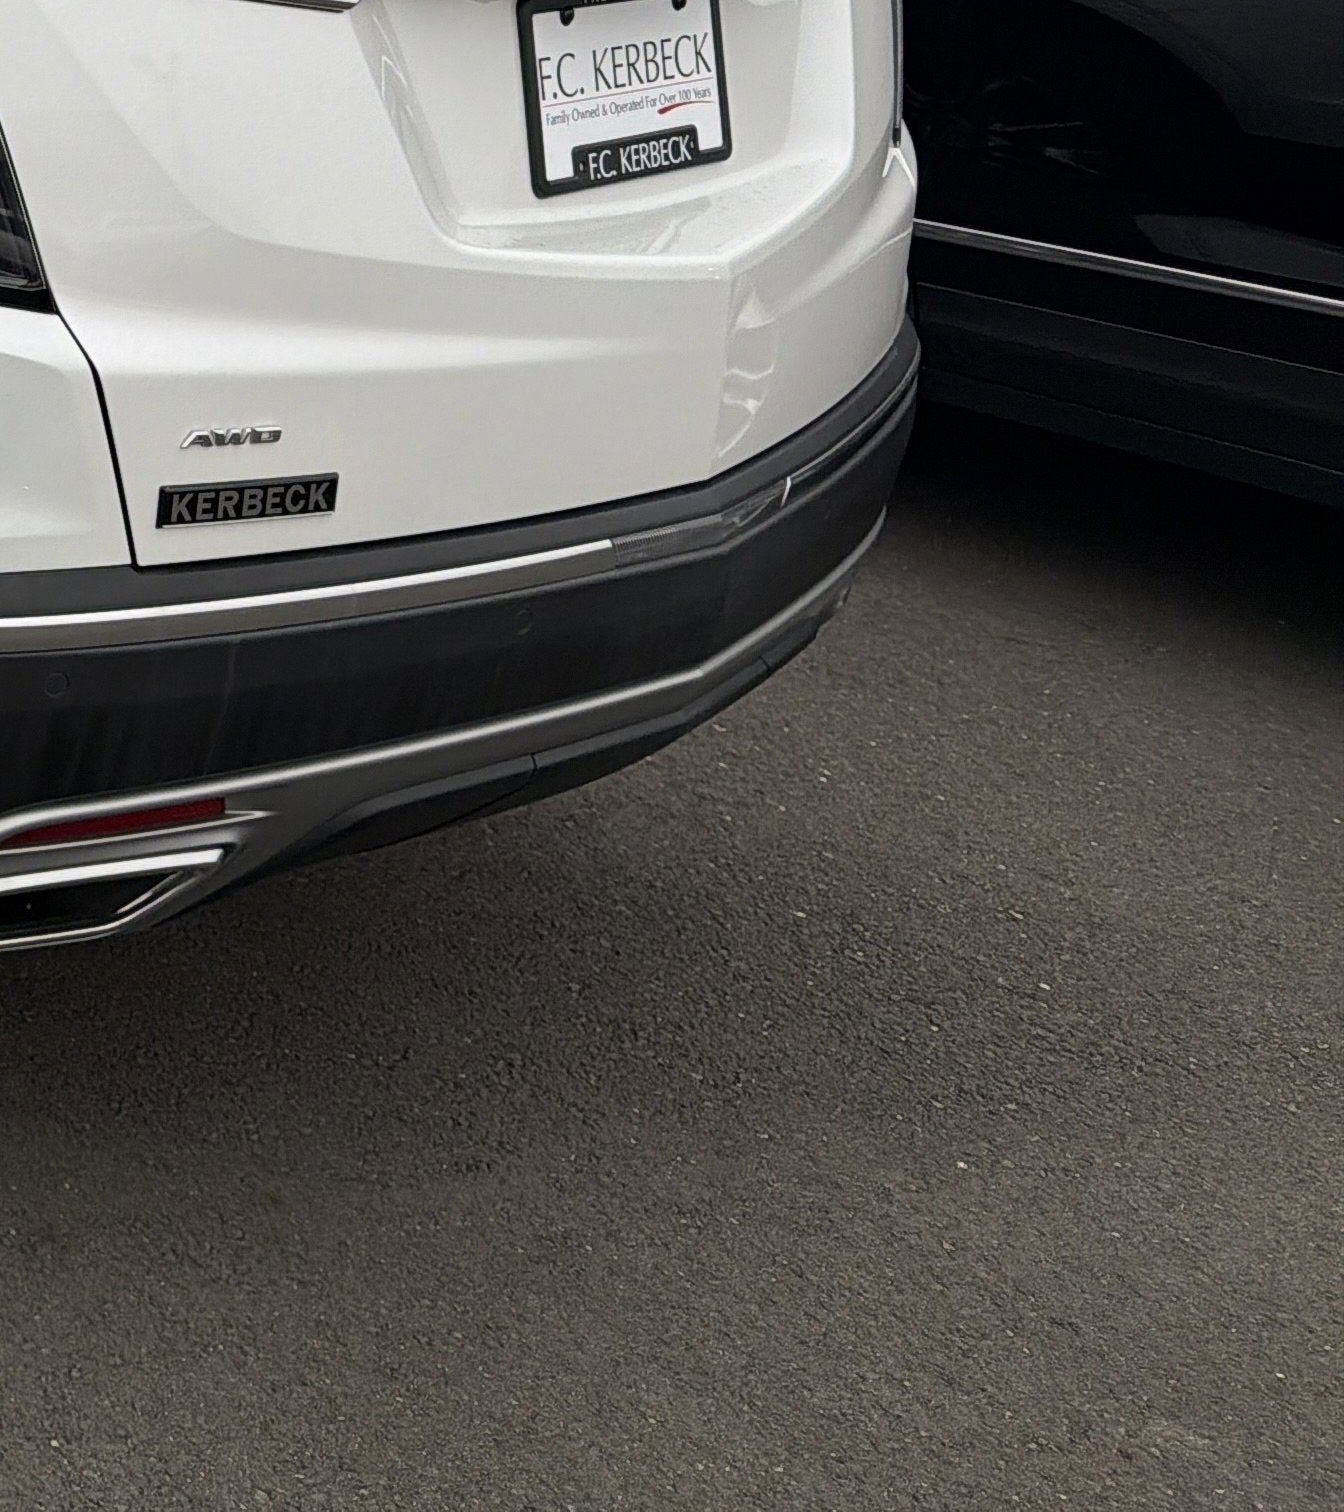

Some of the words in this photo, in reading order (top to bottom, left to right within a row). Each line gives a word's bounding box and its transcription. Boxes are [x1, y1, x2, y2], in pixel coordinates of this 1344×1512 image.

[538, 52, 585, 101] F.C.
[592, 32, 712, 93] KERBECK
[546, 109, 570, 127] Family
[572, 106, 600, 122] Owned
[602, 104, 608, 116] &
[609, 98, 644, 117] Operated
[646, 95, 657, 108] For
[659, 92, 677, 106] Over
[678, 88, 692, 101] 100
[693, 87, 712, 99] Years
[588, 152, 617, 181] F.C.
[620, 134, 692, 175] KERBECK
[180, 425, 282, 448] AWD
[169, 481, 331, 523] KERBECK
